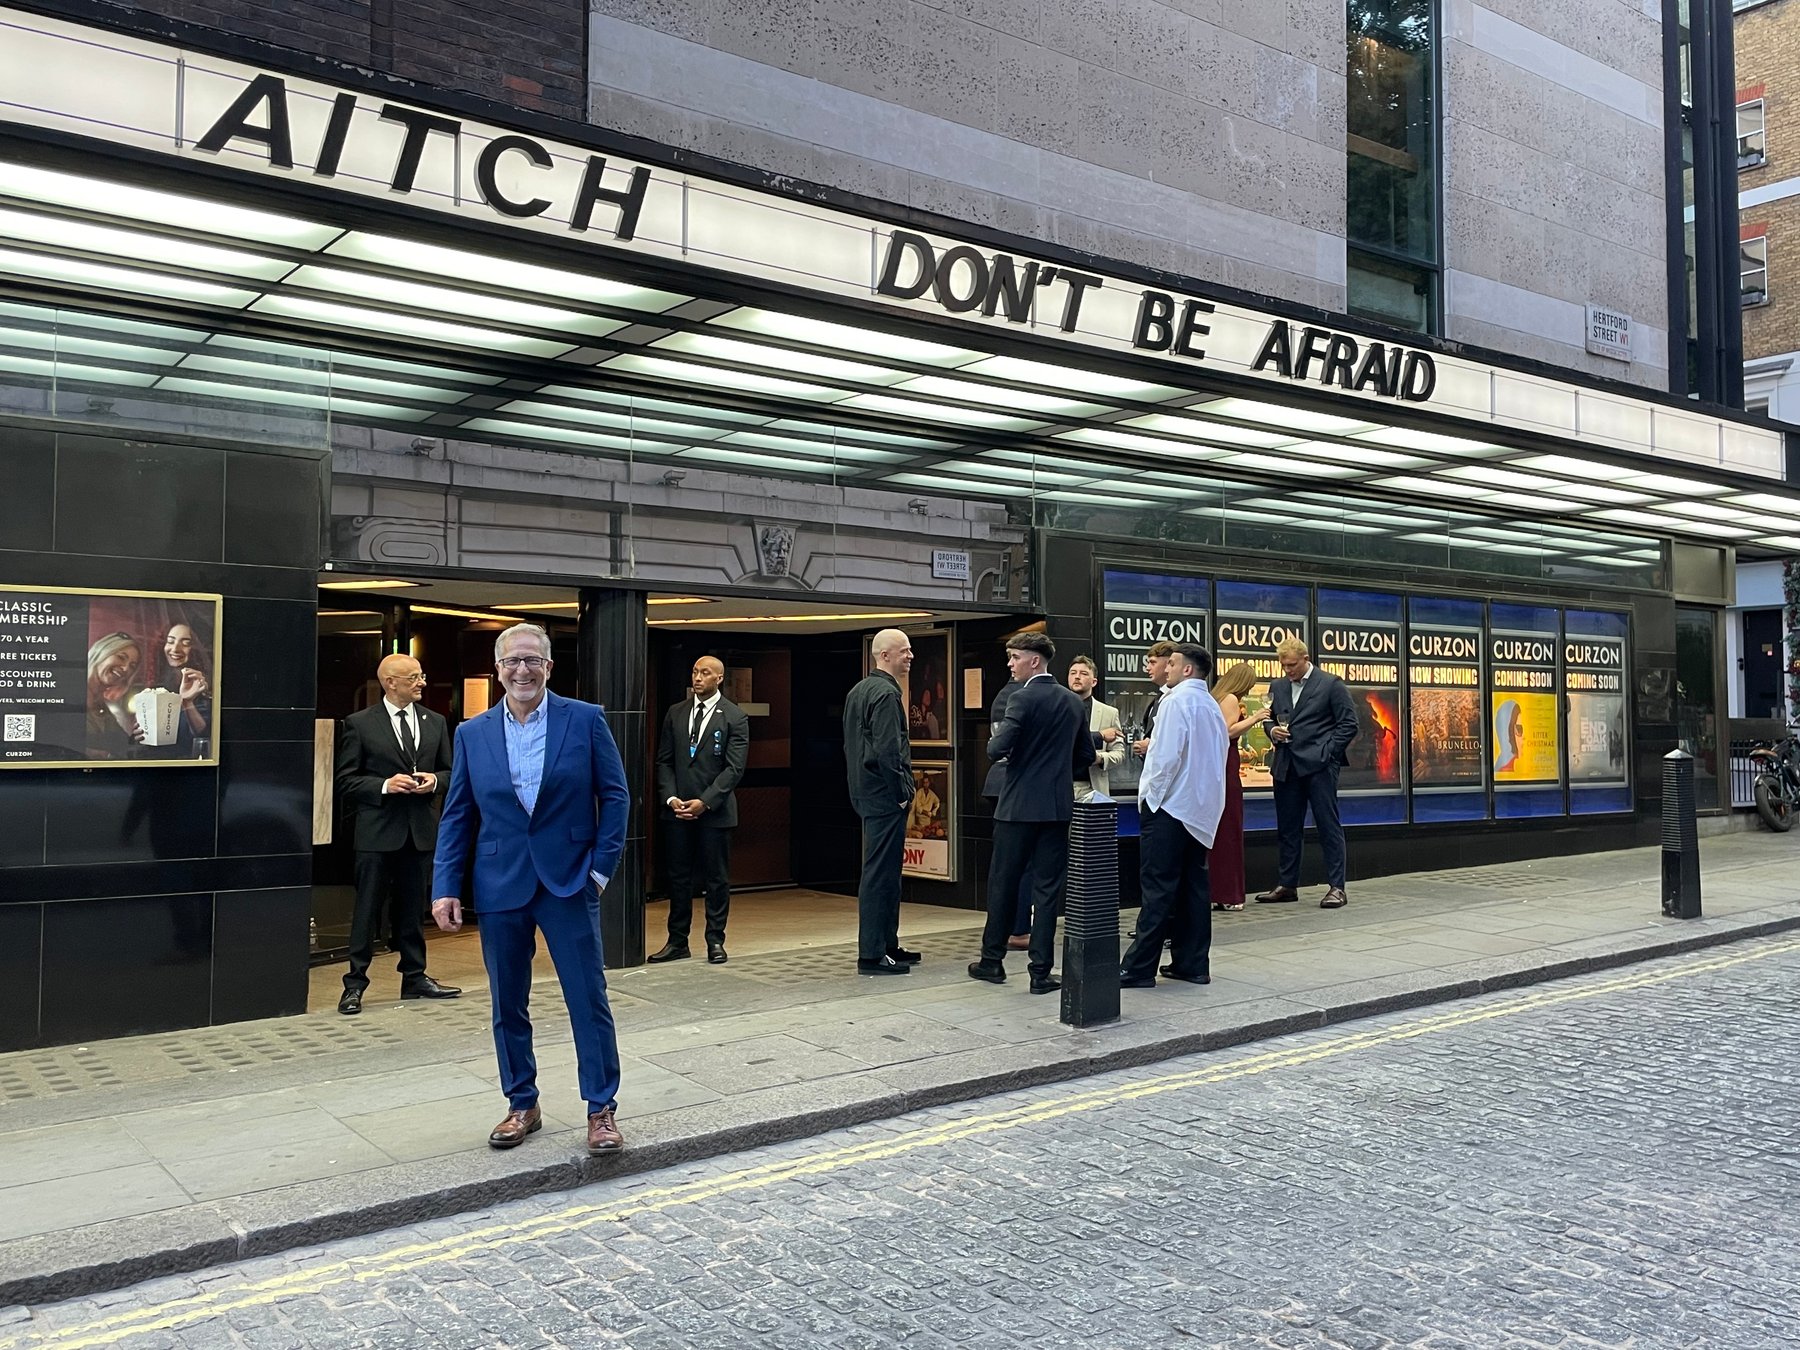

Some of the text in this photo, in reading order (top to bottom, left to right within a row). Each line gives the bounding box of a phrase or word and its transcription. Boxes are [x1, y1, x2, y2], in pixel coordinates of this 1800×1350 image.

[194, 73, 1437, 401] AITCH DON'T BE AFRAID
[1593, 310, 1628, 331] HERTFORD
[1593, 325, 1629, 346] STREET W1
[15, 635, 23, 643] A
[25, 635, 50, 644] YEAR
[1110, 616, 1200, 643] CURZON
[1218, 623, 1299, 648] CURZON
[1322, 629, 1396, 654] CURZON
[1410, 634, 1476, 658] CURZON
[1493, 640, 1553, 662] CURZON
[20, 653, 57, 661] TICKETS
[1107, 653, 1139, 673] NOW
[1565, 644, 1620, 665] CURZON
[1216, 658, 1245, 676] NO
[1348, 663, 1398, 682] SHOWING
[1409, 666, 1478, 685] NOW SHOWING
[16, 680, 24, 688] &
[26, 680, 57, 688] DRINK
[1494, 670, 1553, 688] COMING SOON
[1566, 672, 1619, 690] COMING SOON
[1437, 740, 1480, 750] BRUNELLO
